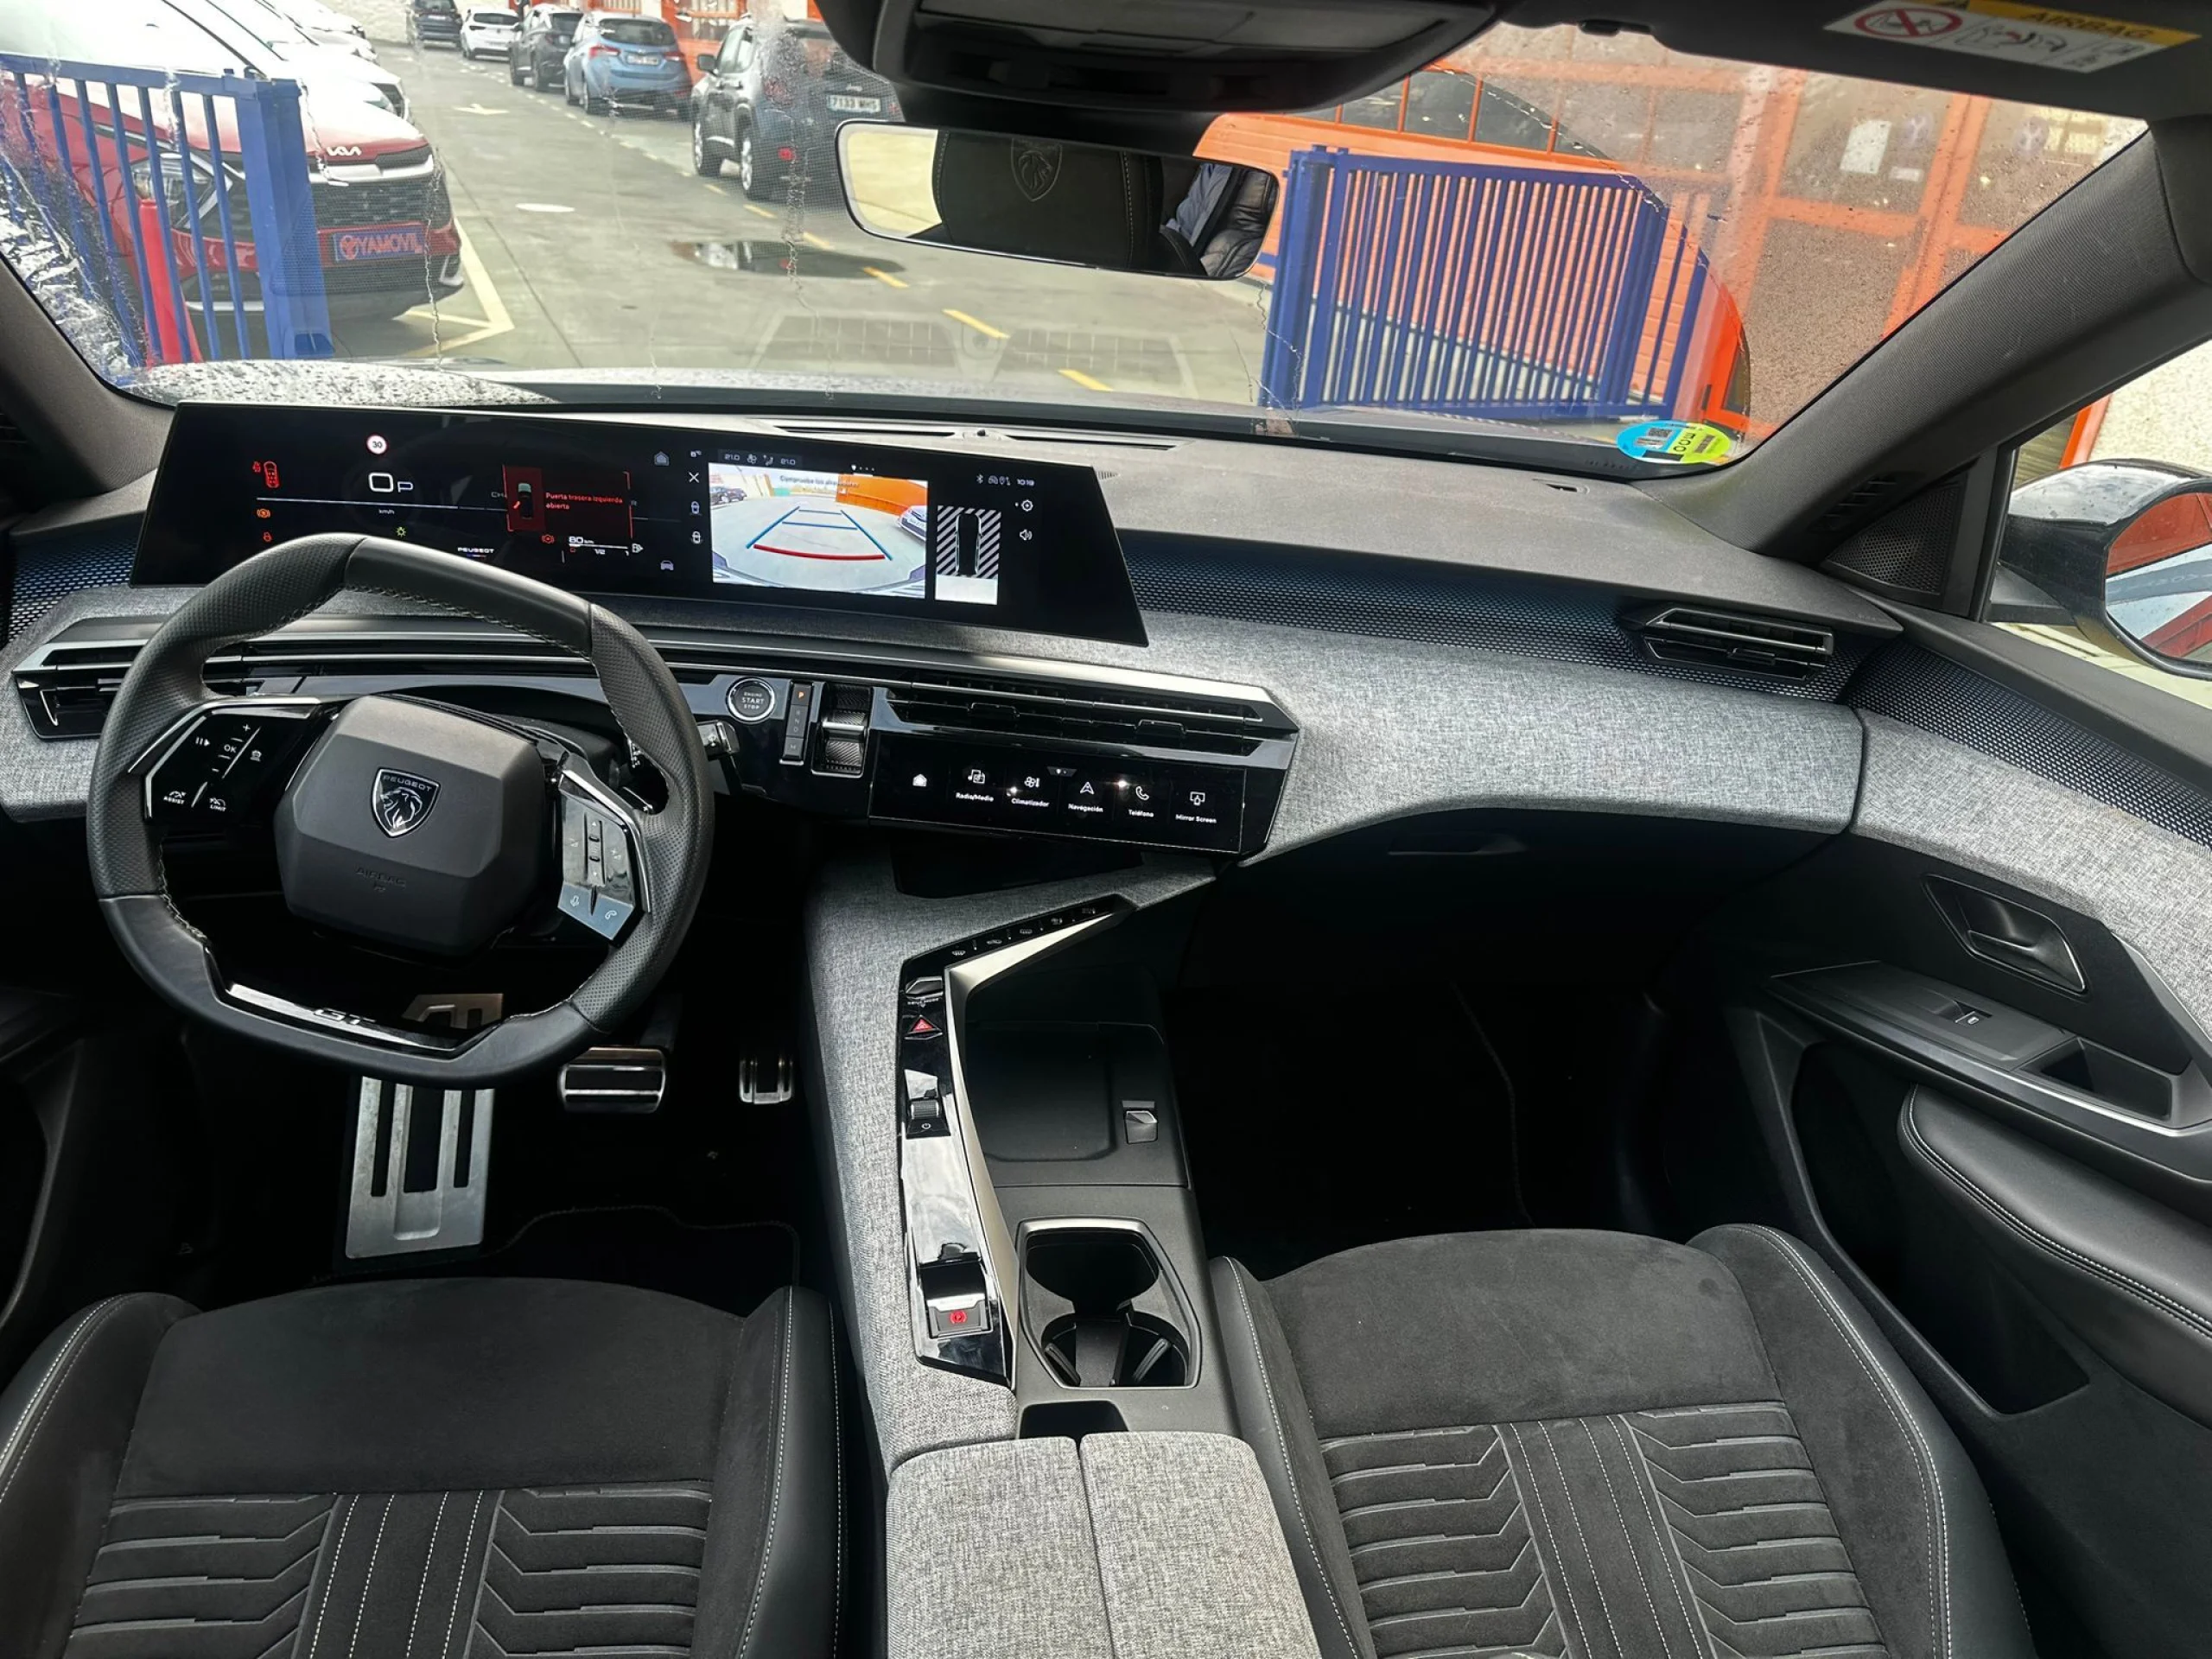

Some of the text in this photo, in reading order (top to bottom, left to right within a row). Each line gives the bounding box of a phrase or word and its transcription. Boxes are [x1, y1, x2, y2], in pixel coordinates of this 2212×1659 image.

[2021, 12, 2155, 38] AIRBAG
[372, 441, 384, 449] 30
[397, 480, 414, 493] P
[545, 492, 568, 500] Puerta
[569, 536, 584, 544] 80
[741, 696, 765, 705] START
[223, 744, 238, 753] OK
[383, 774, 432, 792] PEUGEOT
[163, 795, 185, 804] ASSIST
[956, 791, 995, 803] Radio/Media
[1011, 798, 1050, 807] Climatizador
[1068, 803, 1103, 813] Navegación
[1128, 809, 1154, 817] Teléfono
[1175, 813, 1195, 822] Mirror
